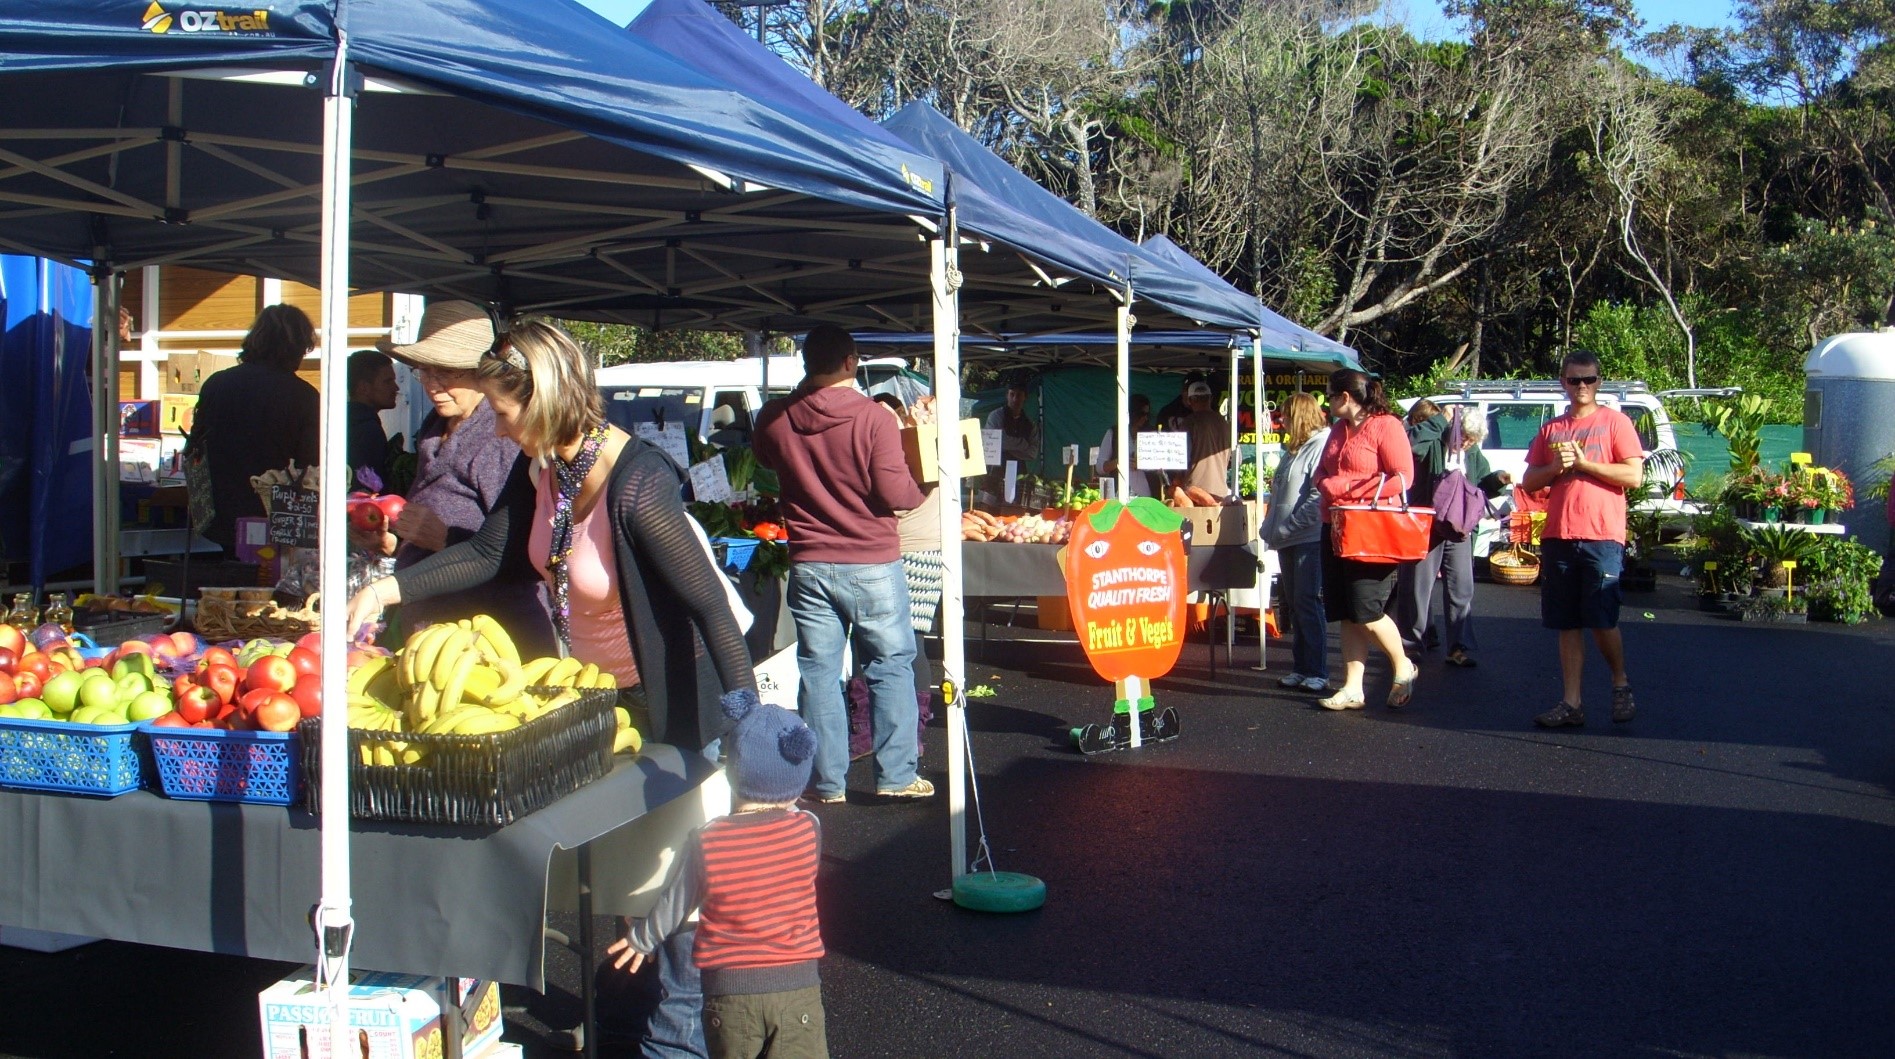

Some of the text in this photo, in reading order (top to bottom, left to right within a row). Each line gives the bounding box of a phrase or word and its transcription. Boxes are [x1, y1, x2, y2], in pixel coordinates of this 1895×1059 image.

[1092, 567, 1167, 590] STANTHORPE
[1088, 586, 1171, 609] QUALITY FRESH
[1088, 619, 1123, 650] Fruit
[1126, 617, 1137, 647] &
[760, 681, 780, 690] ock
